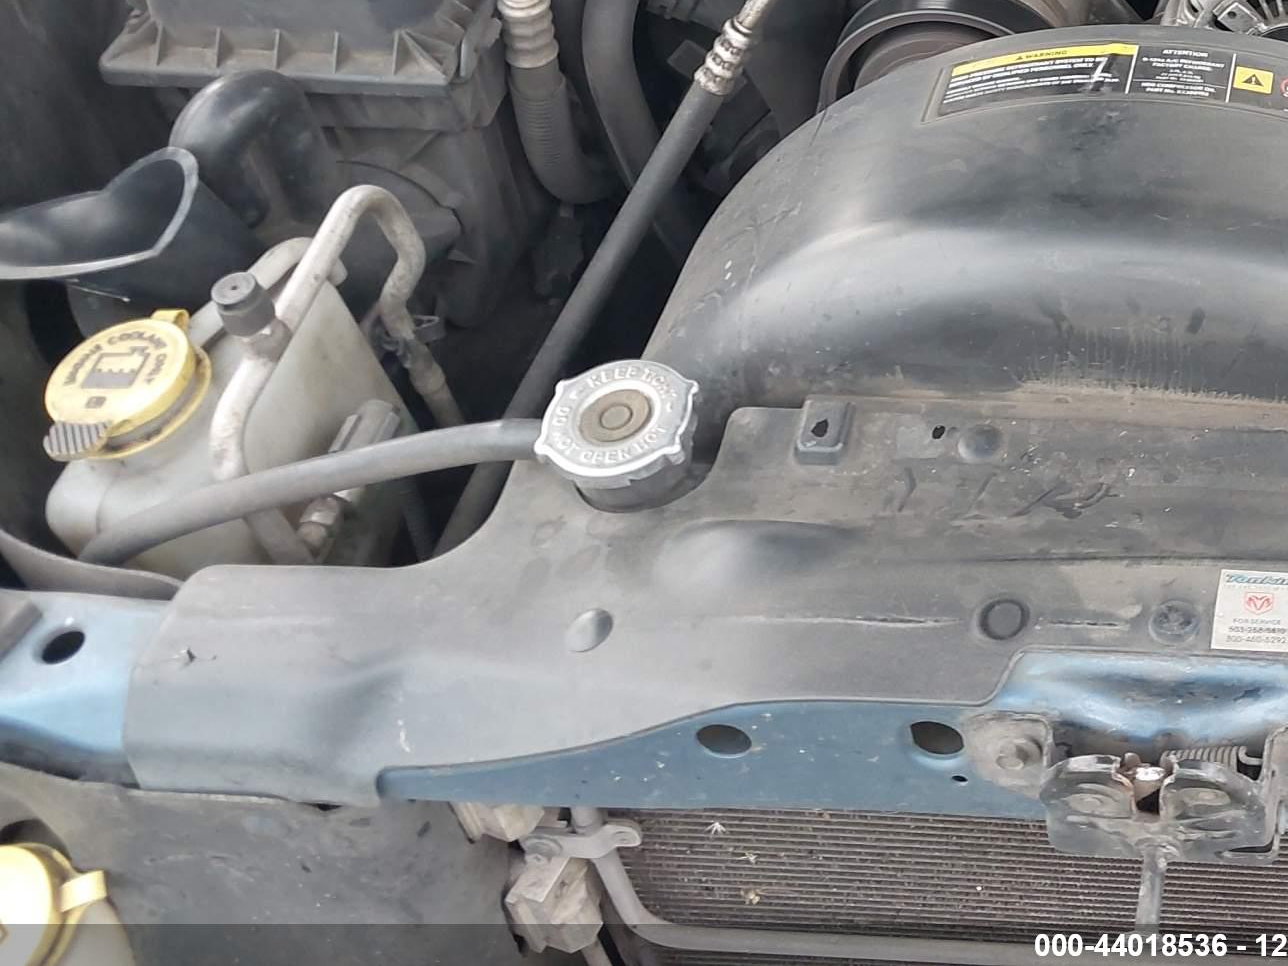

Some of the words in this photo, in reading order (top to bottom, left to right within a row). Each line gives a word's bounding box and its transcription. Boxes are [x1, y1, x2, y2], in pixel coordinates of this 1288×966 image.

[1023, 49, 1068, 60] WARNING
[1162, 49, 1209, 58] ATTENTION
[1232, 617, 1249, 625] FOR
[1250, 618, 1281, 626] SERVICE
